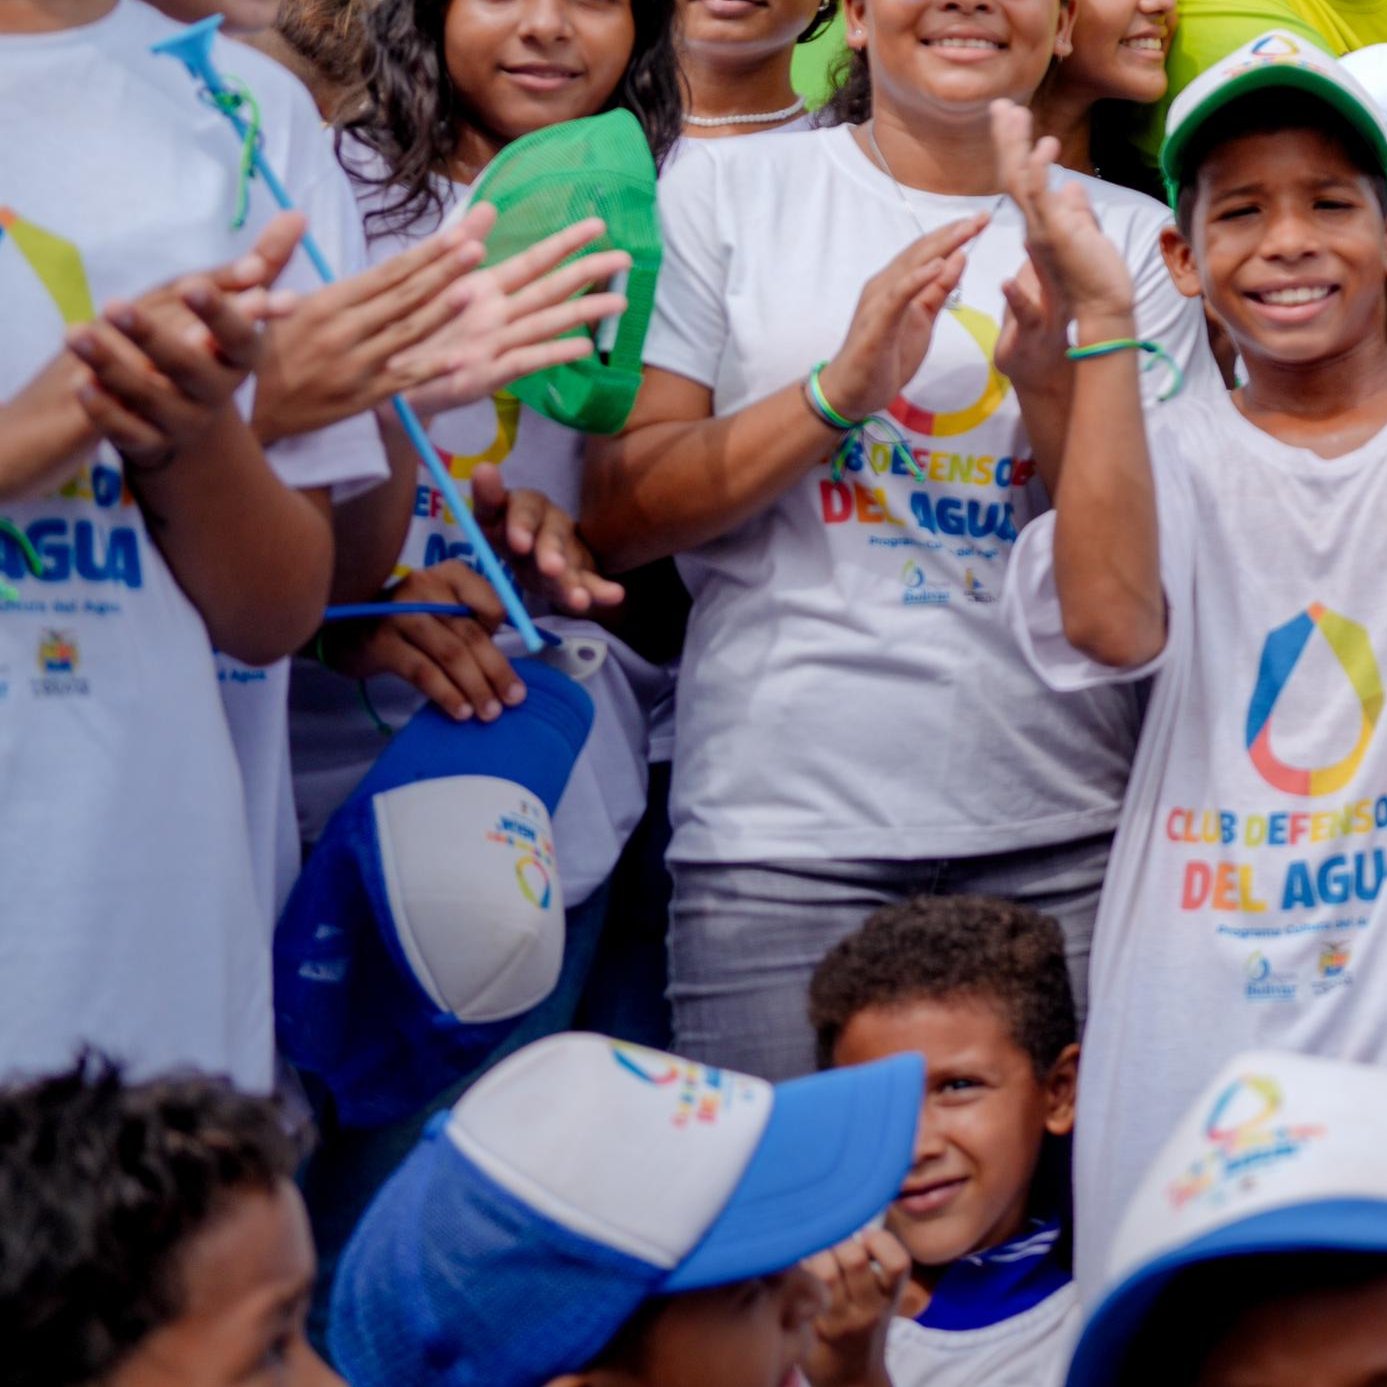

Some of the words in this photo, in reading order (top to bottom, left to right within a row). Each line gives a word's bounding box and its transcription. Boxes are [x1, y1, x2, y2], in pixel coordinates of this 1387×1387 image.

[819, 479, 908, 529] DEL
[1166, 806, 1238, 844] CLUB
[1181, 860, 1267, 912] DEL
